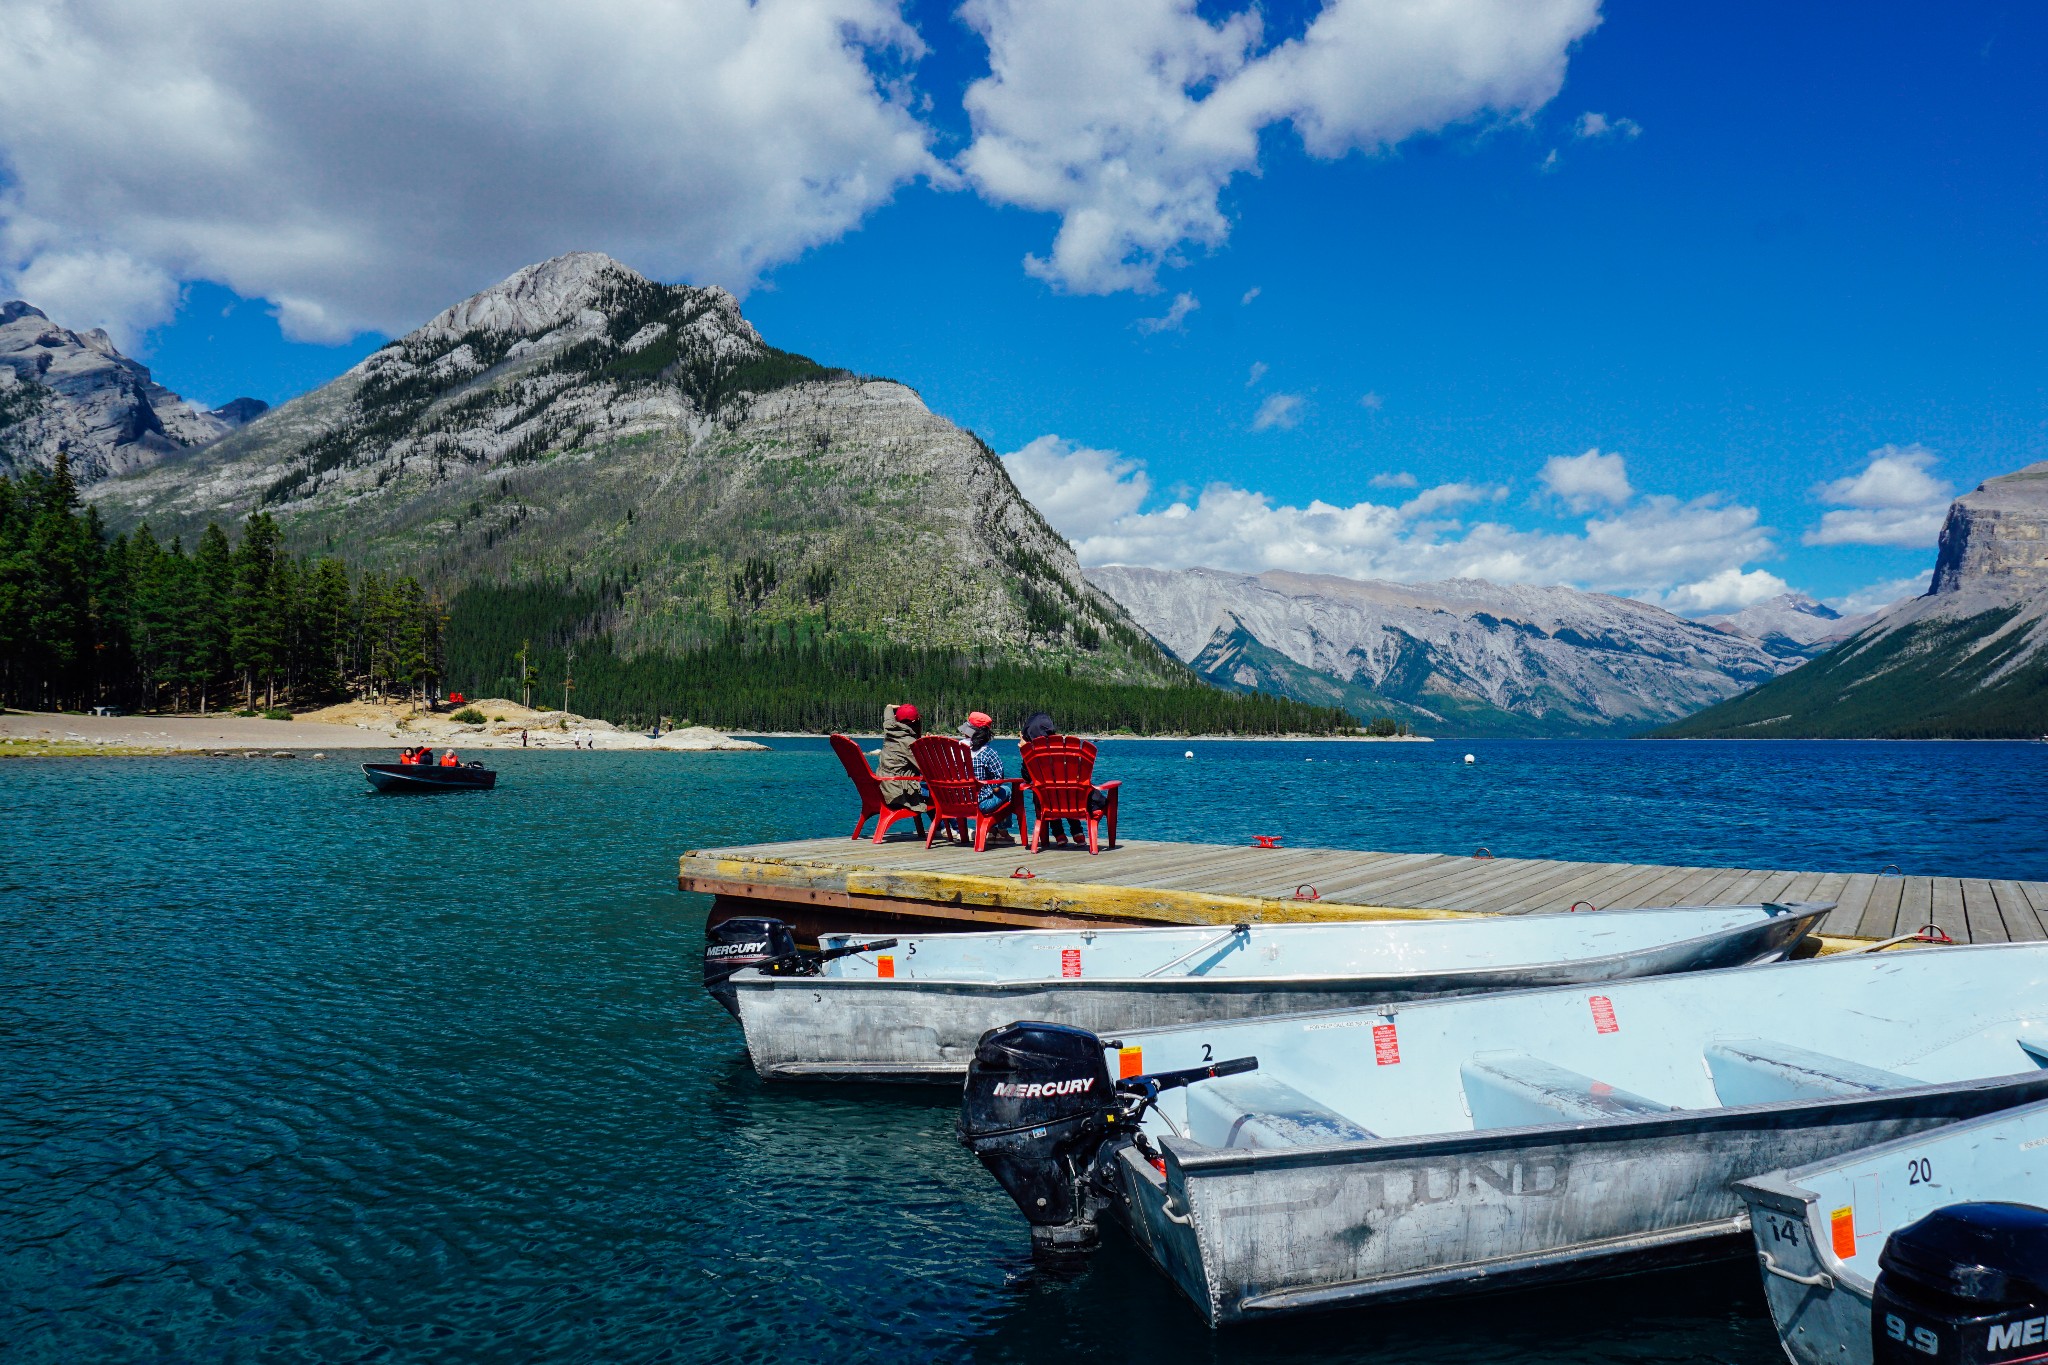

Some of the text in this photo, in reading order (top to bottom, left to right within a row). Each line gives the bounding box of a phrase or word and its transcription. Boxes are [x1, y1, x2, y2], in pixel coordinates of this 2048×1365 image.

[706, 942, 767, 956] MERCURY
[908, 942, 917, 955] 5
[1201, 1043, 1213, 1062] 2
[993, 1078, 1095, 1098] MERCURY
[1907, 1157, 1932, 1185] 20
[1766, 1215, 1800, 1247] 14
[1886, 1312, 1939, 1356] 9.9
[1986, 1315, 2048, 1352] ME
